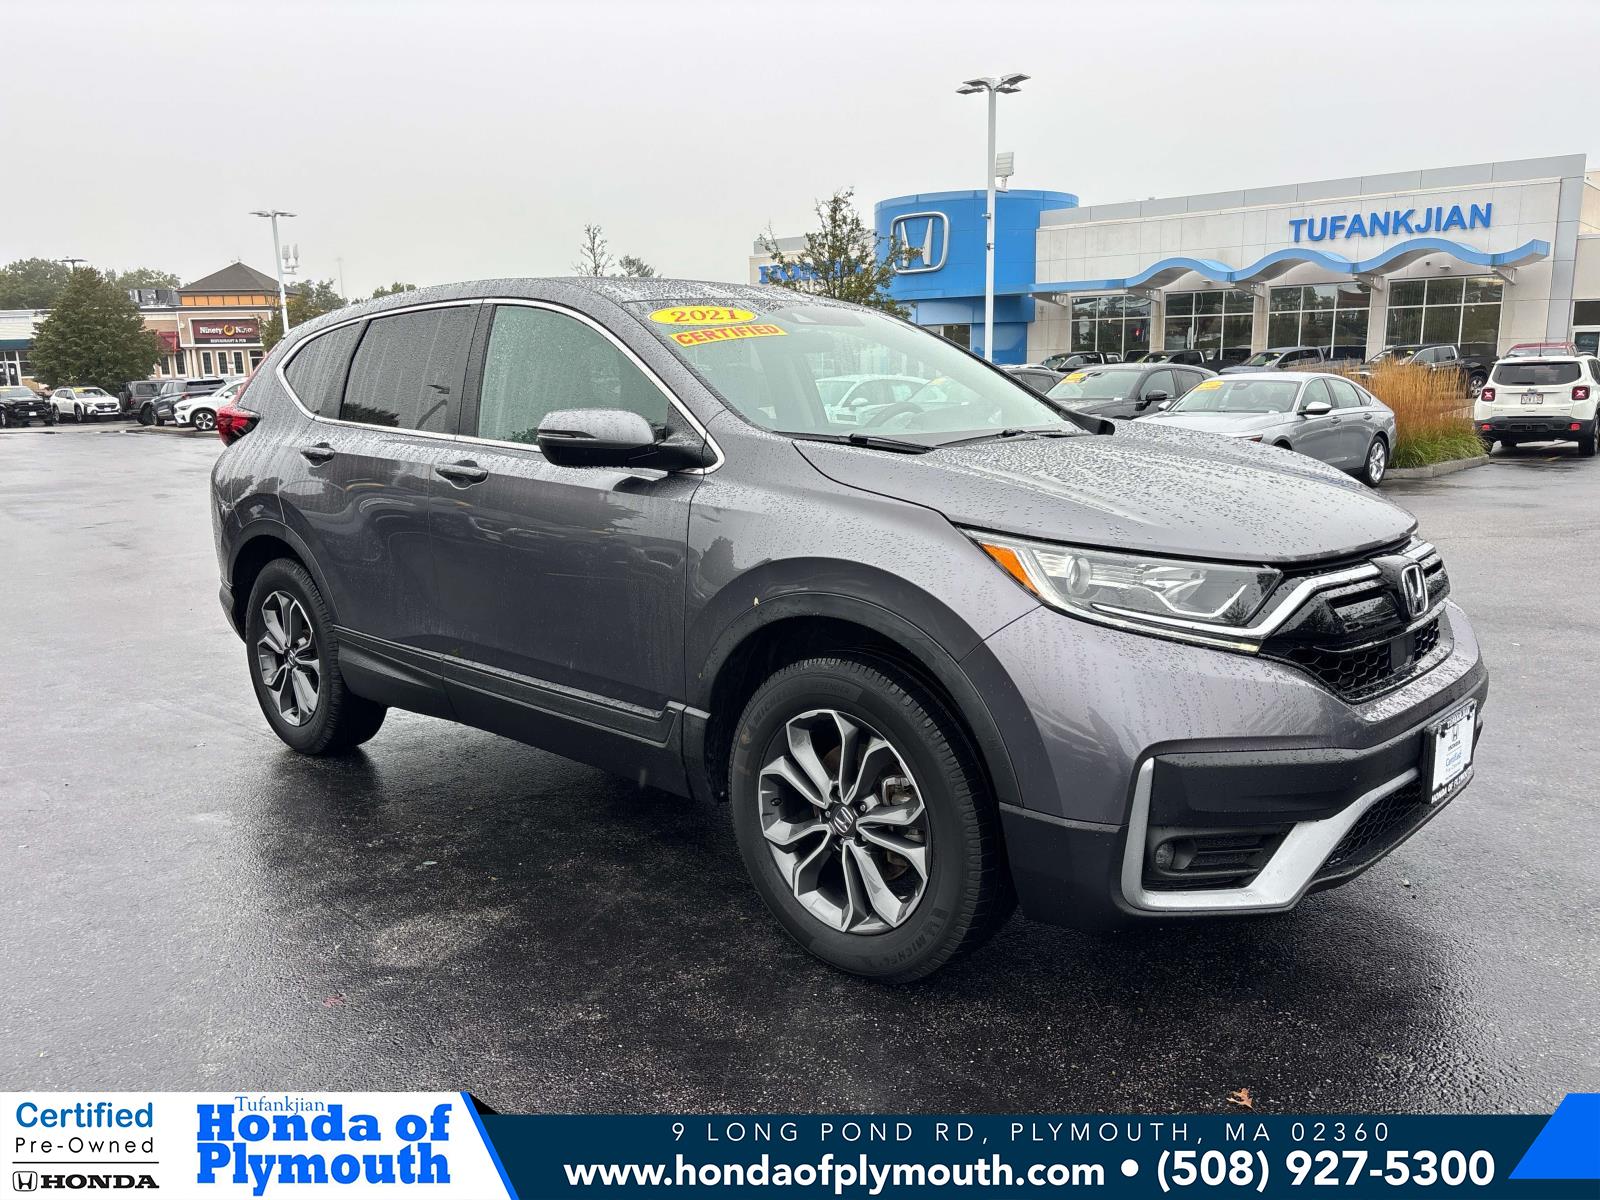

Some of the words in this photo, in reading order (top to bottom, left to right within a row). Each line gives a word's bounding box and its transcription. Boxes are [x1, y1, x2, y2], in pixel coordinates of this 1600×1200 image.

[1288, 202, 1492, 242] TUFANKJIAN
[670, 309, 740, 322] 2021
[675, 325, 780, 345] CERTIFIED
